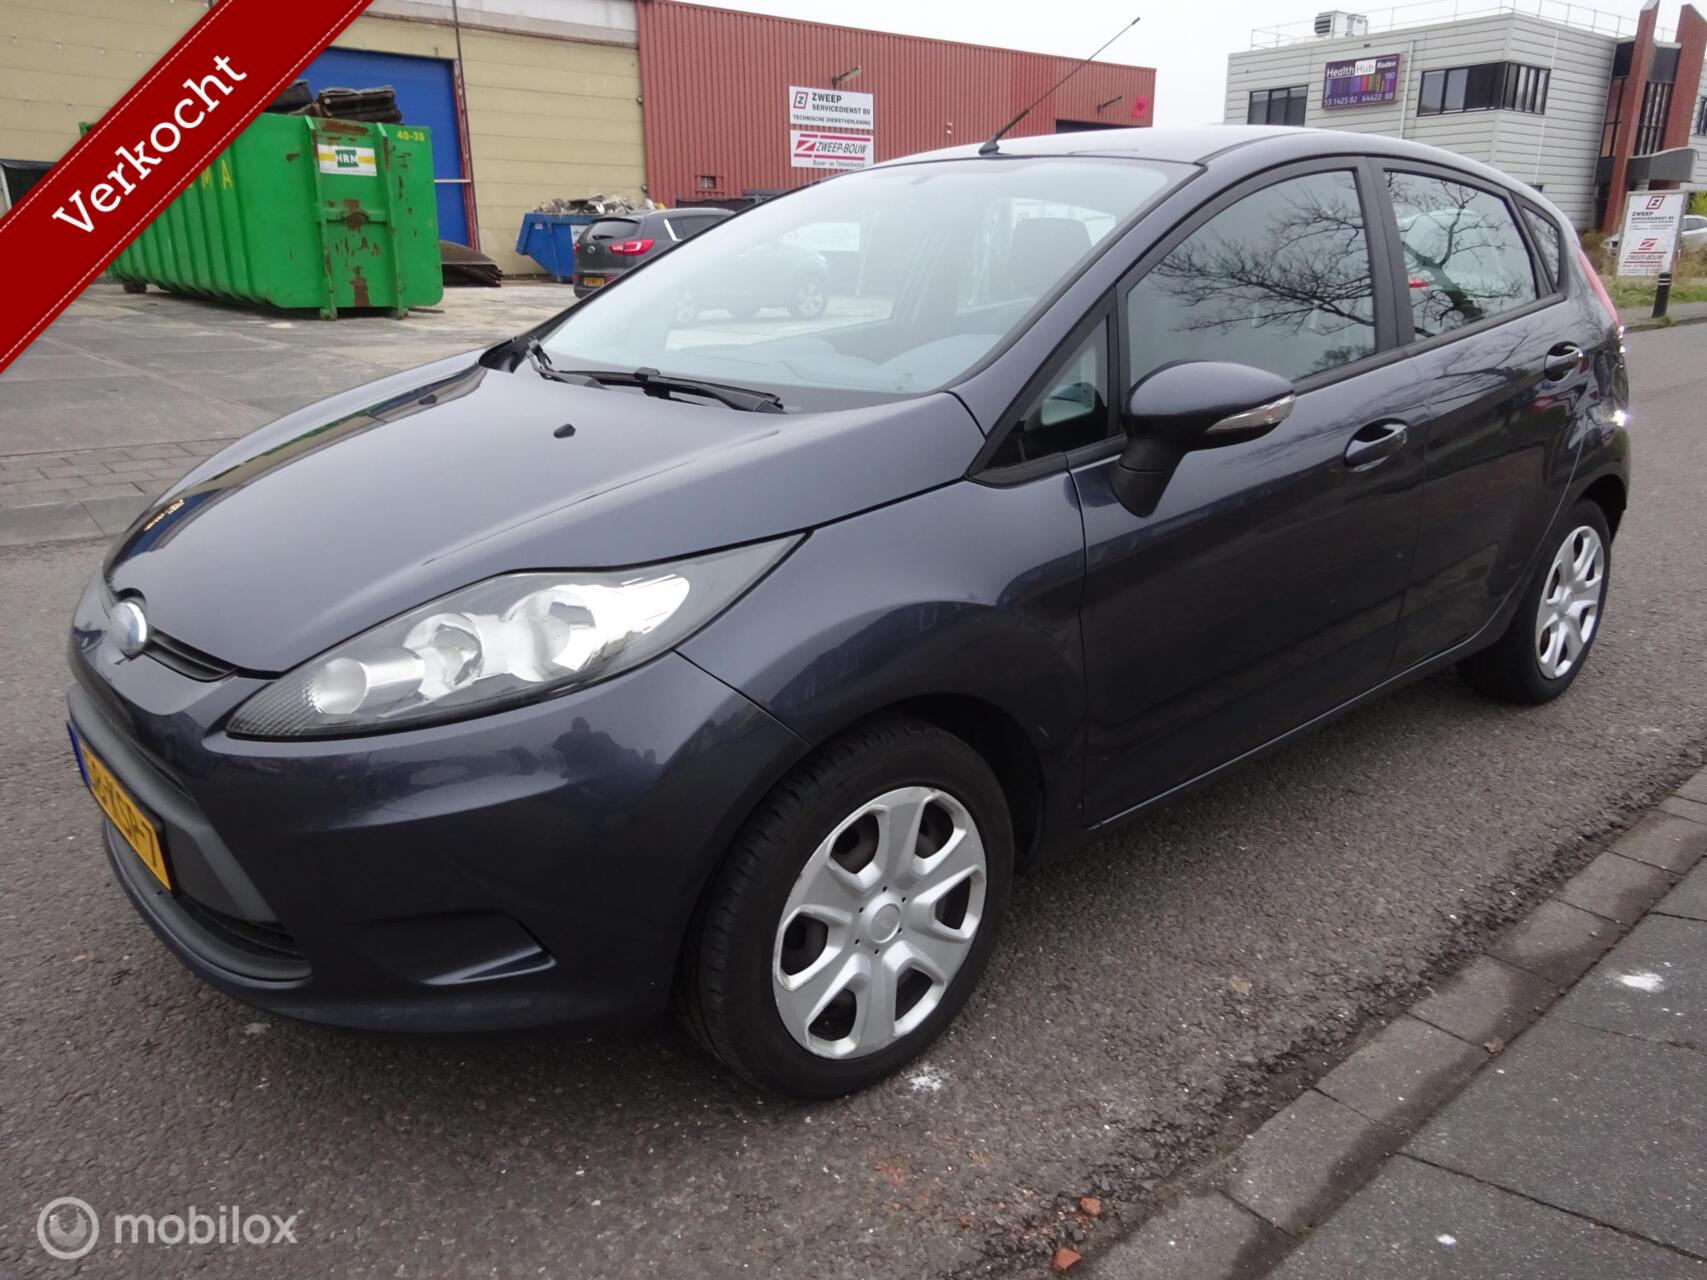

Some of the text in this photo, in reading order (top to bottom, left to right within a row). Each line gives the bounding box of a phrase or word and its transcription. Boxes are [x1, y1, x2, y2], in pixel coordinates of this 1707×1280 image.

[812, 93, 842, 103] ZWEEP
[812, 104, 861, 114] SERVICEDIENST
[793, 114, 825, 122] TECHNISCHE
[816, 141, 868, 154] ZWEEP-BOUW
